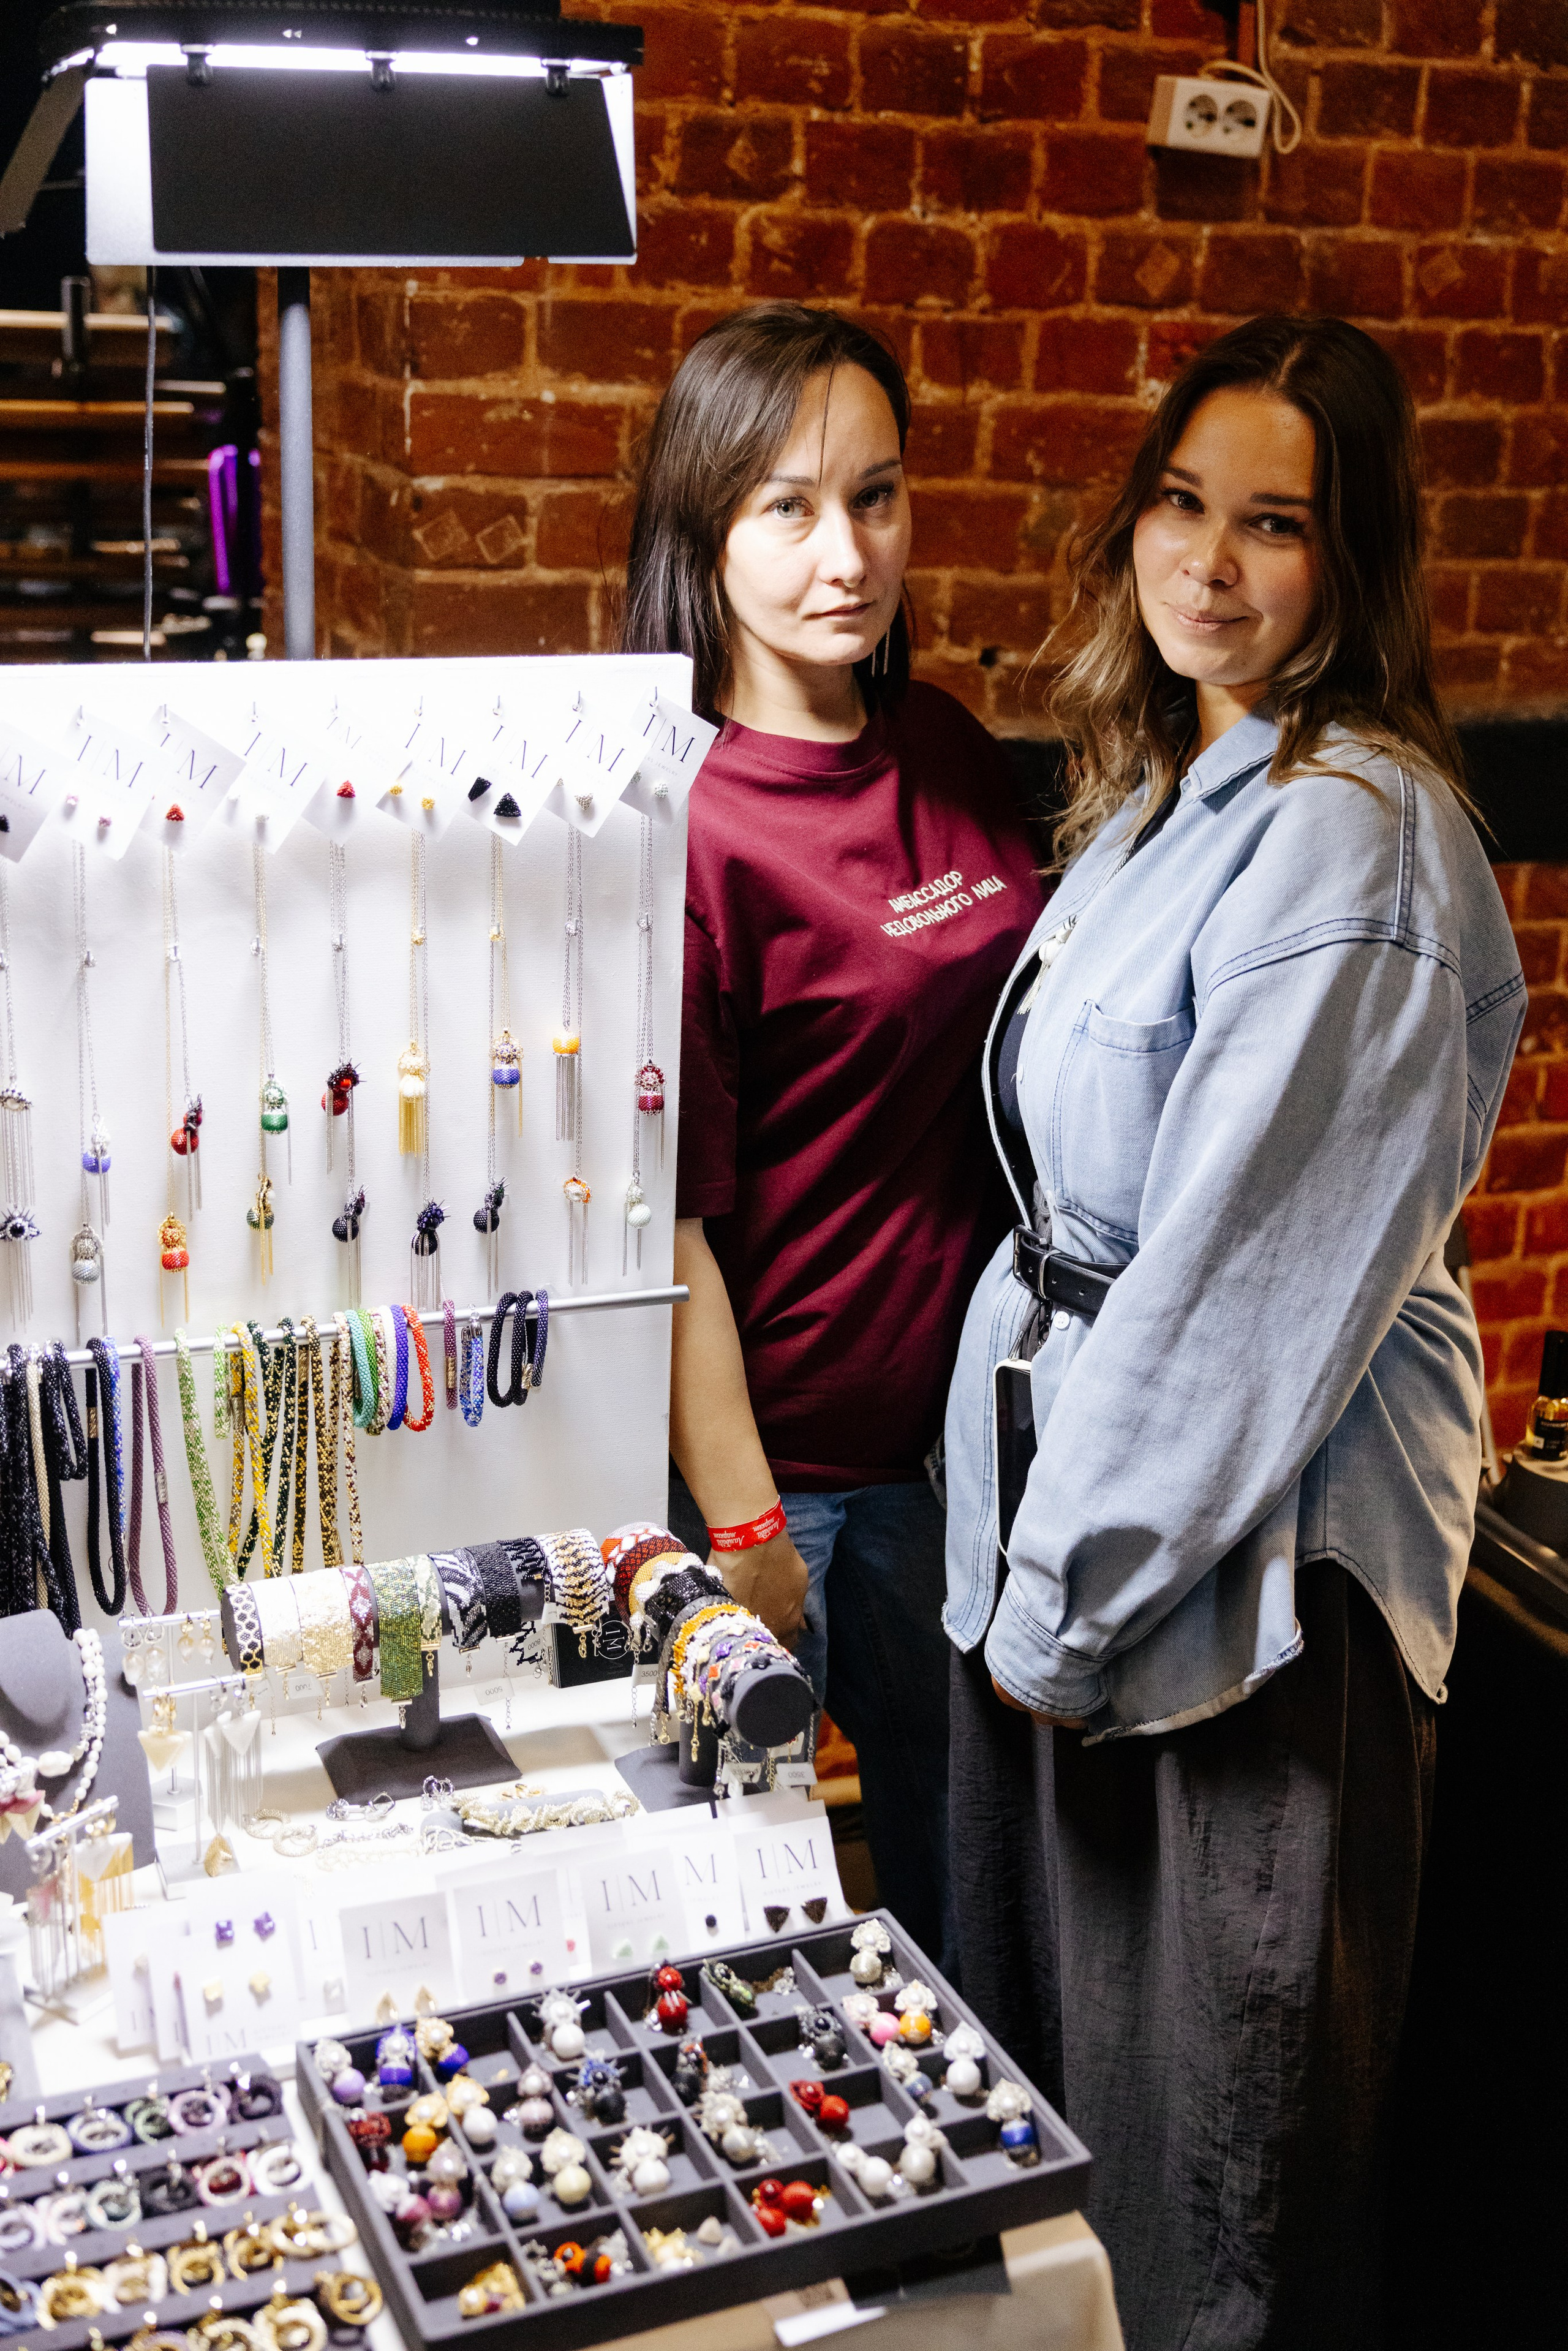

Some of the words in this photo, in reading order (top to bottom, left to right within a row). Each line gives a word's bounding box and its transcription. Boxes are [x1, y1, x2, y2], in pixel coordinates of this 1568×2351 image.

[888, 870, 963, 913] АМБАССАДОР
[880, 892, 973, 937] НЕДОВОЛЬНОГО
[971, 875, 1008, 900] ЛИЦА
[717, 1535, 745, 1548] Ламбада
[527, 1638, 541, 1651] 8000
[295, 1683, 312, 1692] 7000
[485, 1686, 503, 1696] 5000
